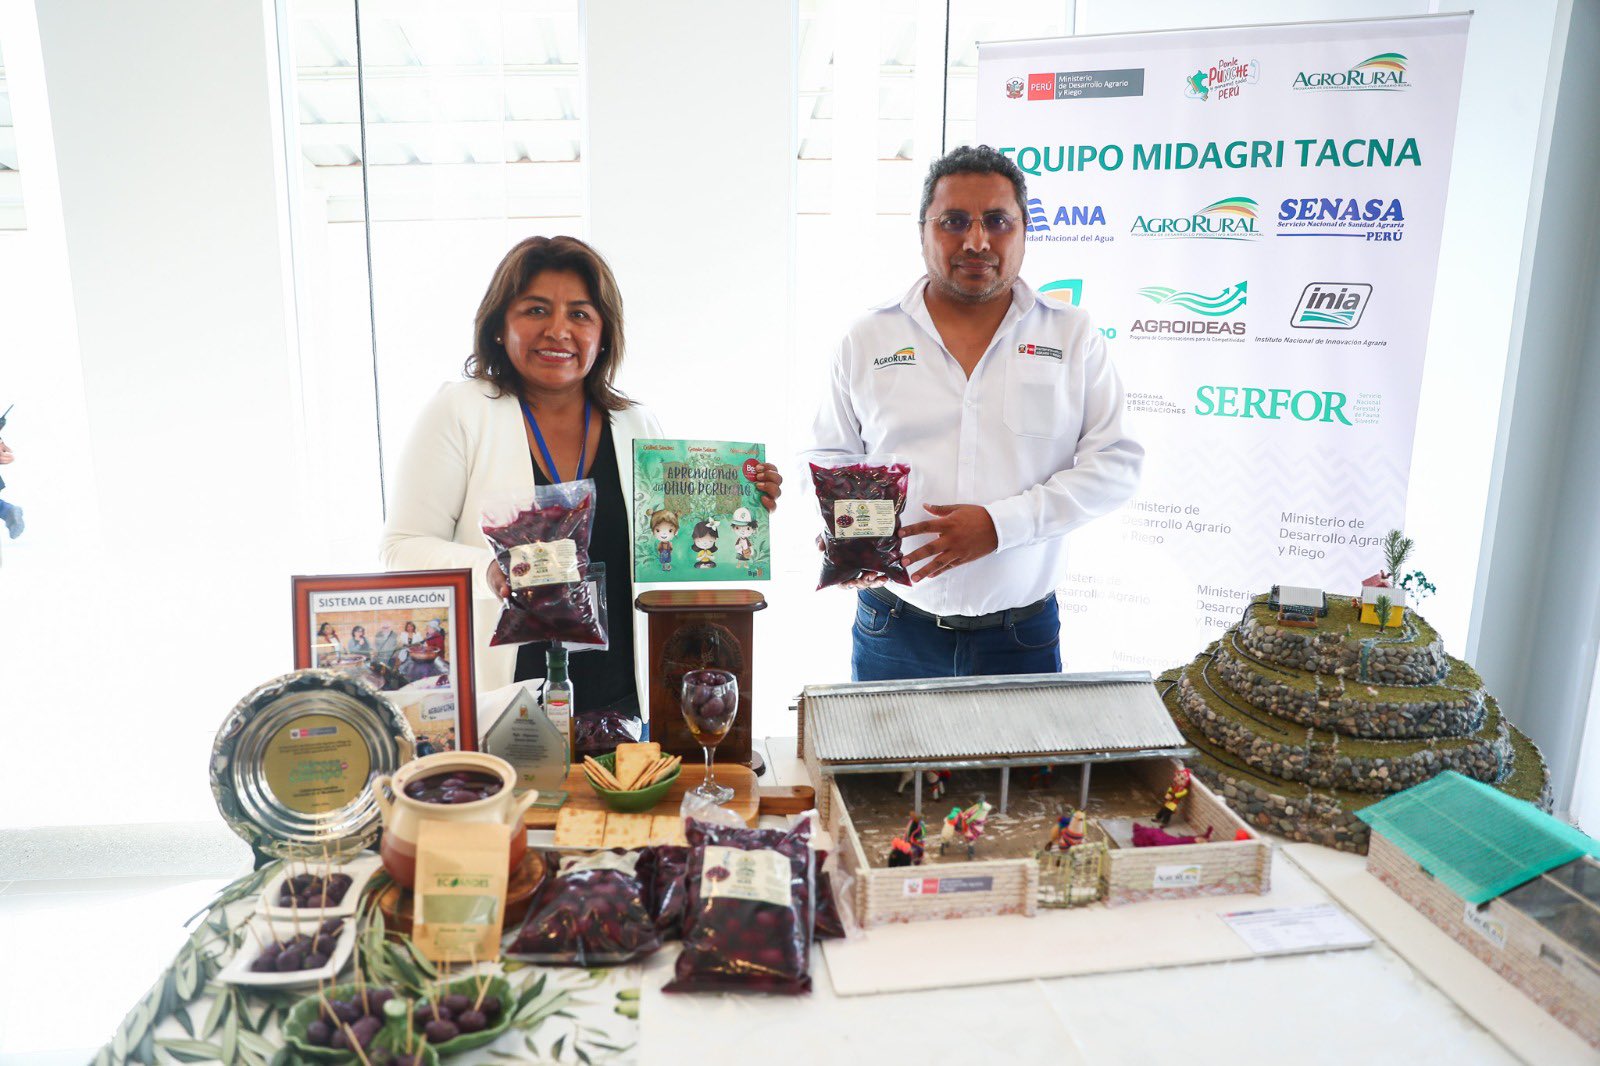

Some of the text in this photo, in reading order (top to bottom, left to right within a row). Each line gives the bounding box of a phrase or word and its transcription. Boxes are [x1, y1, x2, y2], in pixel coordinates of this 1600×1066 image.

[1058, 75, 1092, 83] Ministerio
[1208, 64, 1248, 86] PUNCHE
[1292, 70, 1408, 88] AGRORURAL
[1030, 81, 1052, 91] PERÚ
[1068, 81, 1103, 89] Desarrollo
[1104, 80, 1129, 89] Agrario
[1063, 89, 1082, 97] Riego
[1218, 85, 1240, 100] PERÚ
[1132, 140, 1284, 171] MIDAGRI
[1295, 138, 1422, 168] TACNA
[1053, 206, 1106, 226] ANA
[1278, 198, 1404, 222] SENASA
[1130, 214, 1260, 233] AGRORURAL
[1094, 235, 1114, 243] Agua
[1366, 229, 1403, 241] PERÚ
[1306, 287, 1360, 310] inia
[1130, 320, 1246, 335] AGROIDEAS
[874, 354, 916, 366] AGRORURAL
[1127, 400, 1176, 408] UBSECTORIAL
[1134, 406, 1186, 415] IRRIGACIONES
[1195, 386, 1353, 426] SERFOR
[1184, 505, 1200, 515] de
[1185, 520, 1231, 534] Agrario
[1280, 512, 1364, 529] Ministerio de
[1131, 530, 1164, 544] Riego
[1280, 528, 1346, 544] Desarrollo
[1278, 545, 1325, 560] y Riego
[319, 592, 445, 607] SISTEMA DE AIREACIÓN
